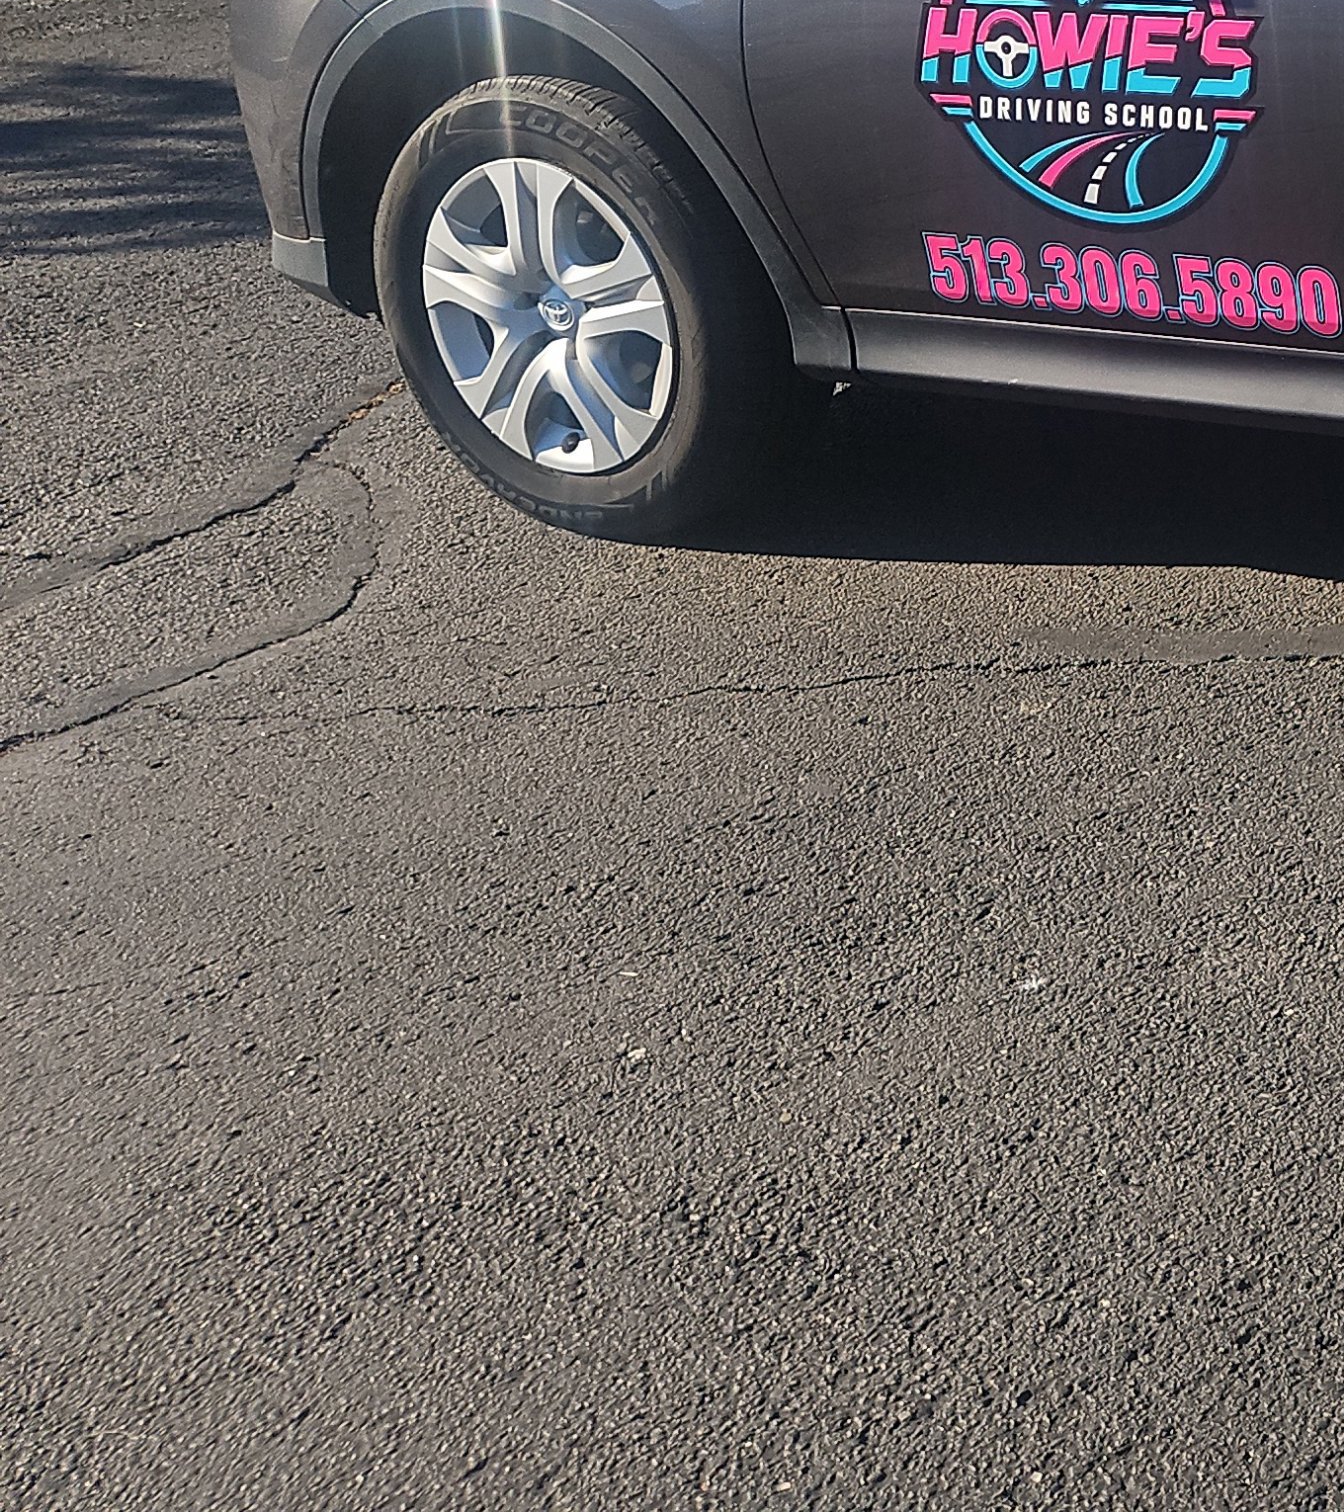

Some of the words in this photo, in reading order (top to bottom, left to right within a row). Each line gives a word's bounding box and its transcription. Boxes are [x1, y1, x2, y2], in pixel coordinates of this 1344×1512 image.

[920, 6, 1256, 99] HOWIE'S
[979, 96, 1091, 125] DRIVING
[1104, 102, 1209, 133] SCHOOL
[921, 231, 1344, 339] 513.306.5890
